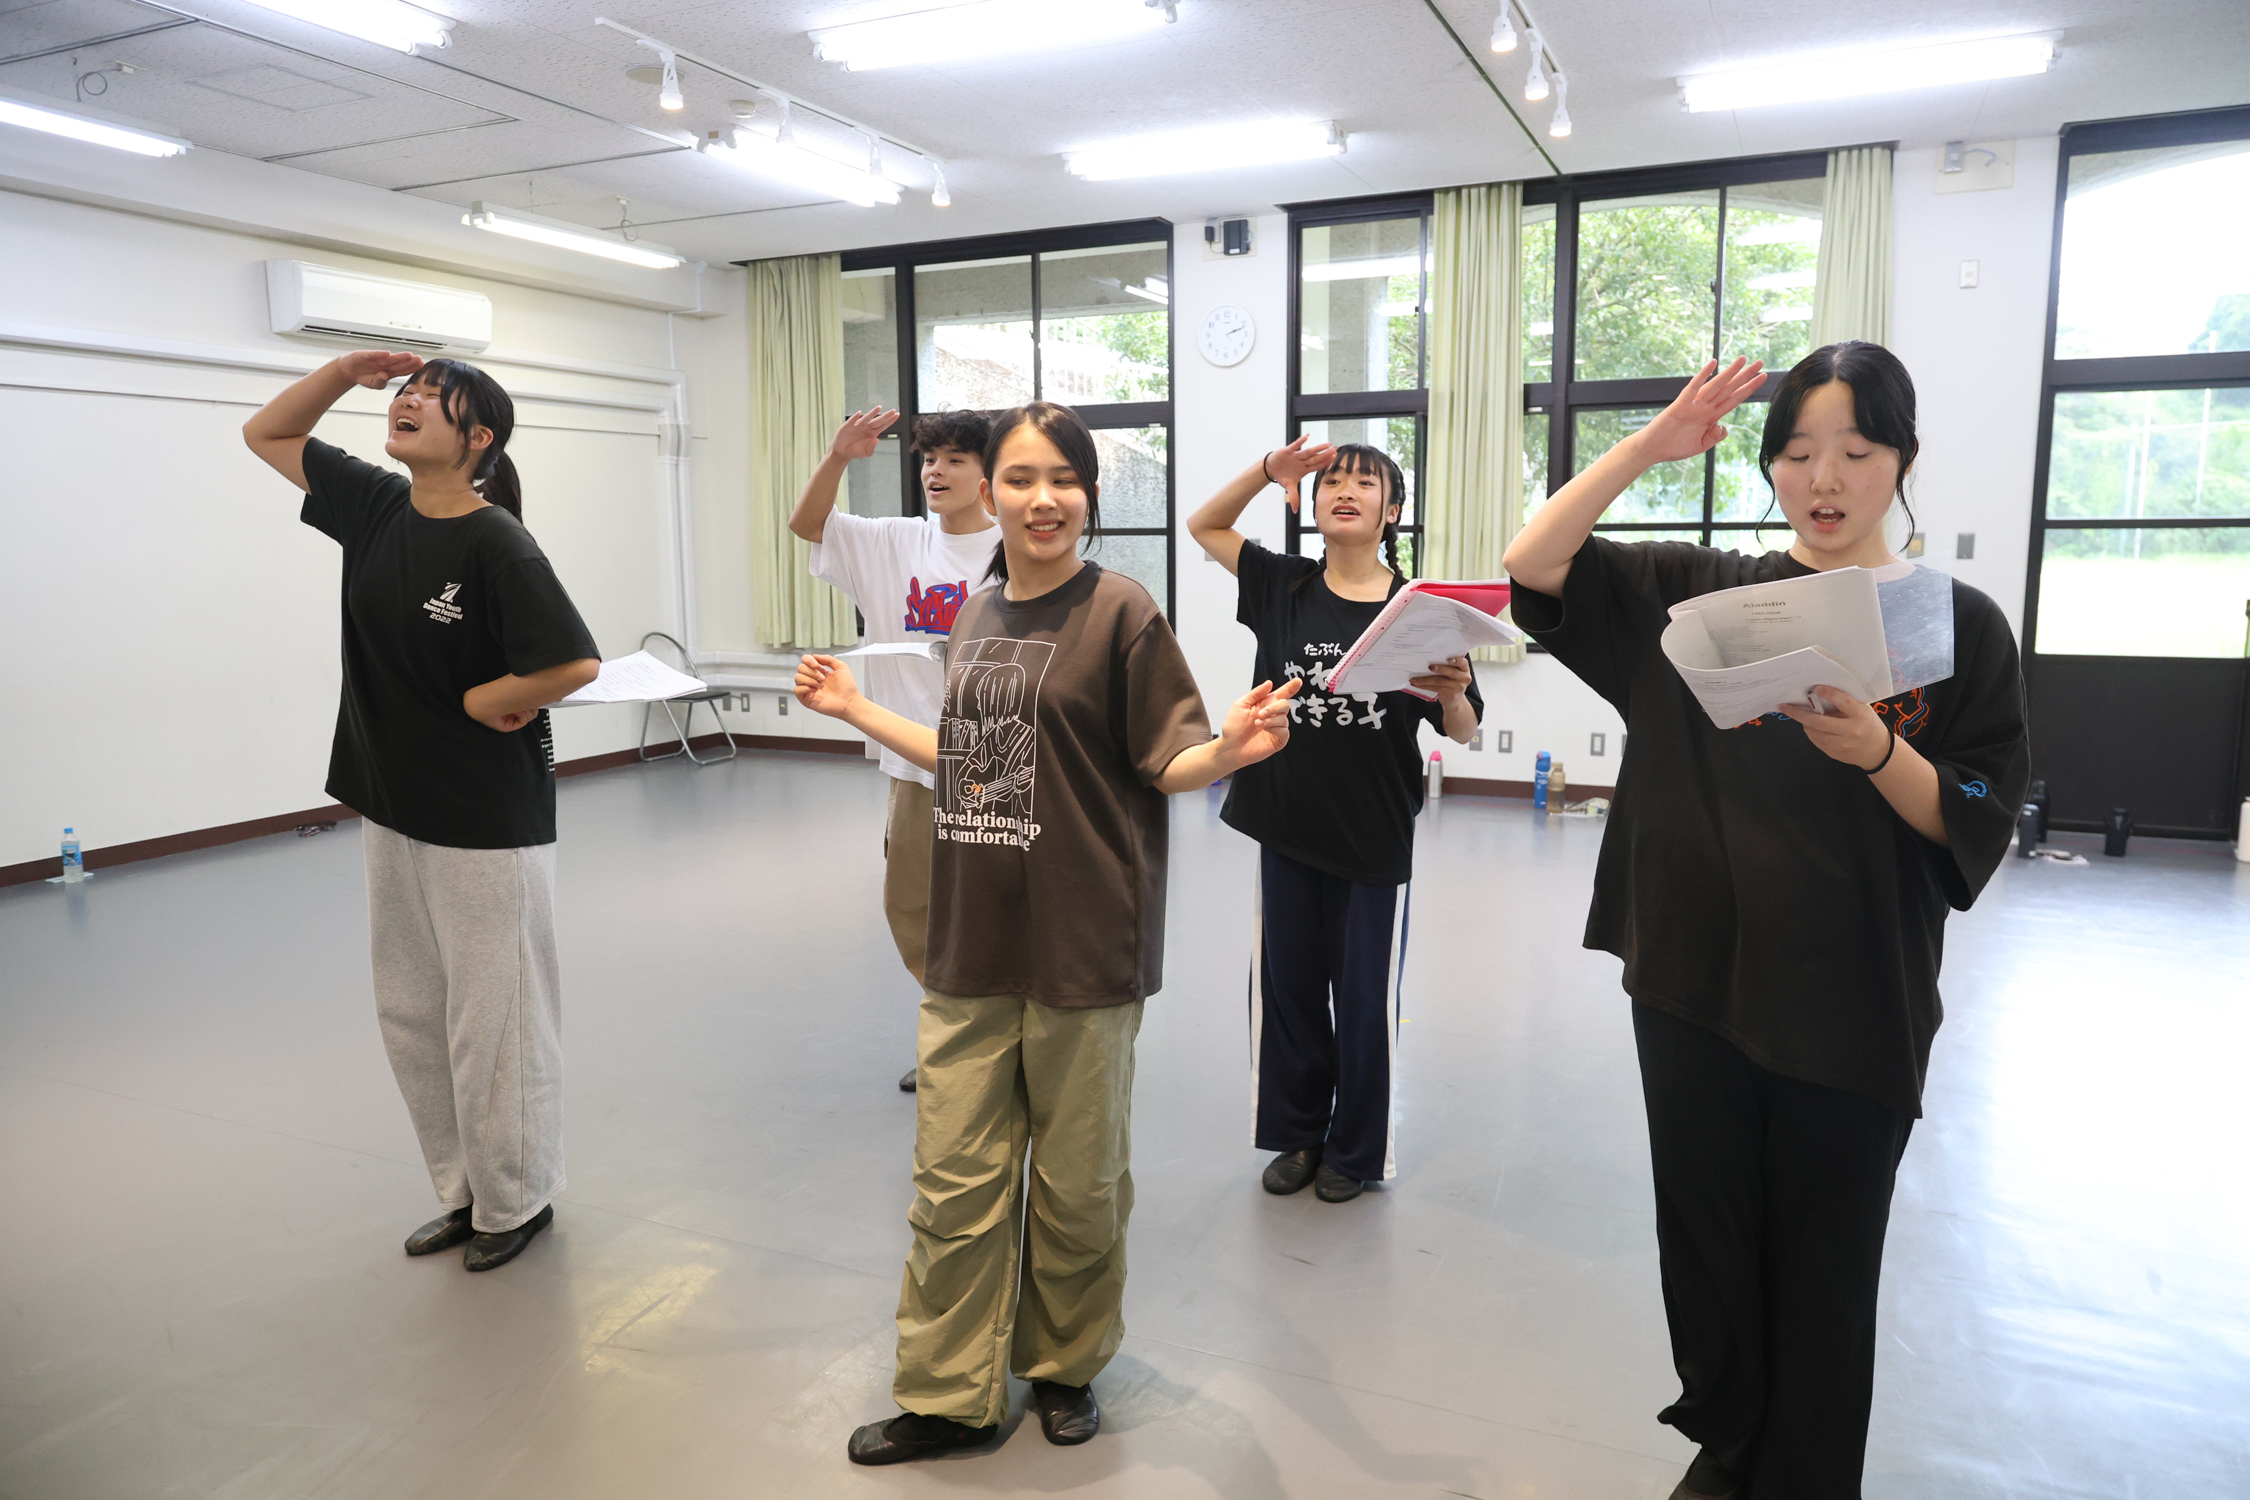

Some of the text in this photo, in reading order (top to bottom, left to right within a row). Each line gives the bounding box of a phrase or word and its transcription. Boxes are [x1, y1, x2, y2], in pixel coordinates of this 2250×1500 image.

[423, 602, 464, 620] Dance Festival
[429, 597, 462, 613] Japan Youth
[429, 612, 452, 624] 2022
[1303, 642, 1347, 657] たぶん
[1287, 692, 1388, 730] できる子
[933, 806, 954, 824] The
[937, 823, 949, 840] is
